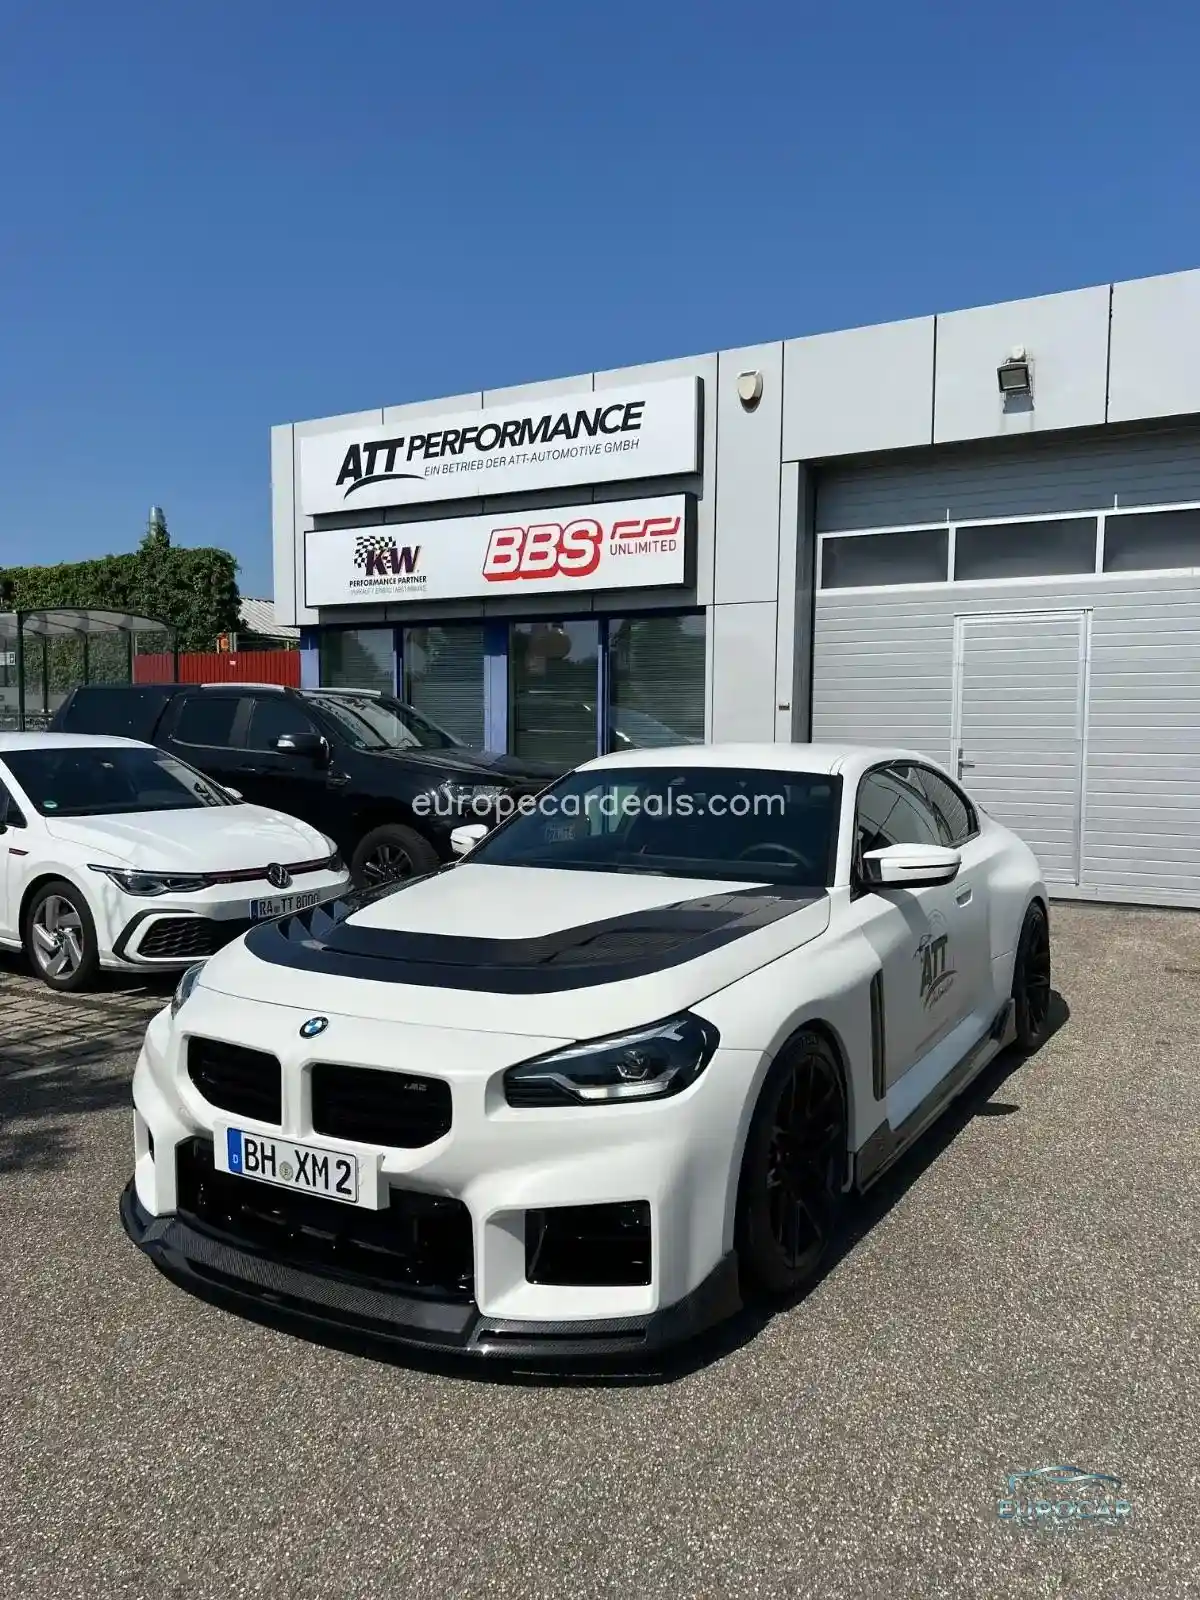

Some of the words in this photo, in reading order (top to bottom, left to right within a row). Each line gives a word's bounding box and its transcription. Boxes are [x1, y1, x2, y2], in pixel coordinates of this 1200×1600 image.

[336, 437, 405, 486] ATT
[406, 401, 645, 461] PERFORMANCE
[424, 465, 440, 476] EIN
[441, 459, 484, 474] BETRIEB
[485, 456, 507, 469] DER
[508, 443, 602, 465] ATT-AUTOMOTIVE
[604, 438, 640, 453] GMBH
[366, 545, 421, 576] KW
[482, 518, 603, 581] BBS
[610, 539, 677, 556] UNLIMITED
[349, 577, 397, 588] PERFORMANCE
[397, 575, 427, 585] PARTNER
[260, 900, 273, 916] RA
[281, 896, 294, 912] TT
[244, 1138, 276, 1177] BH
